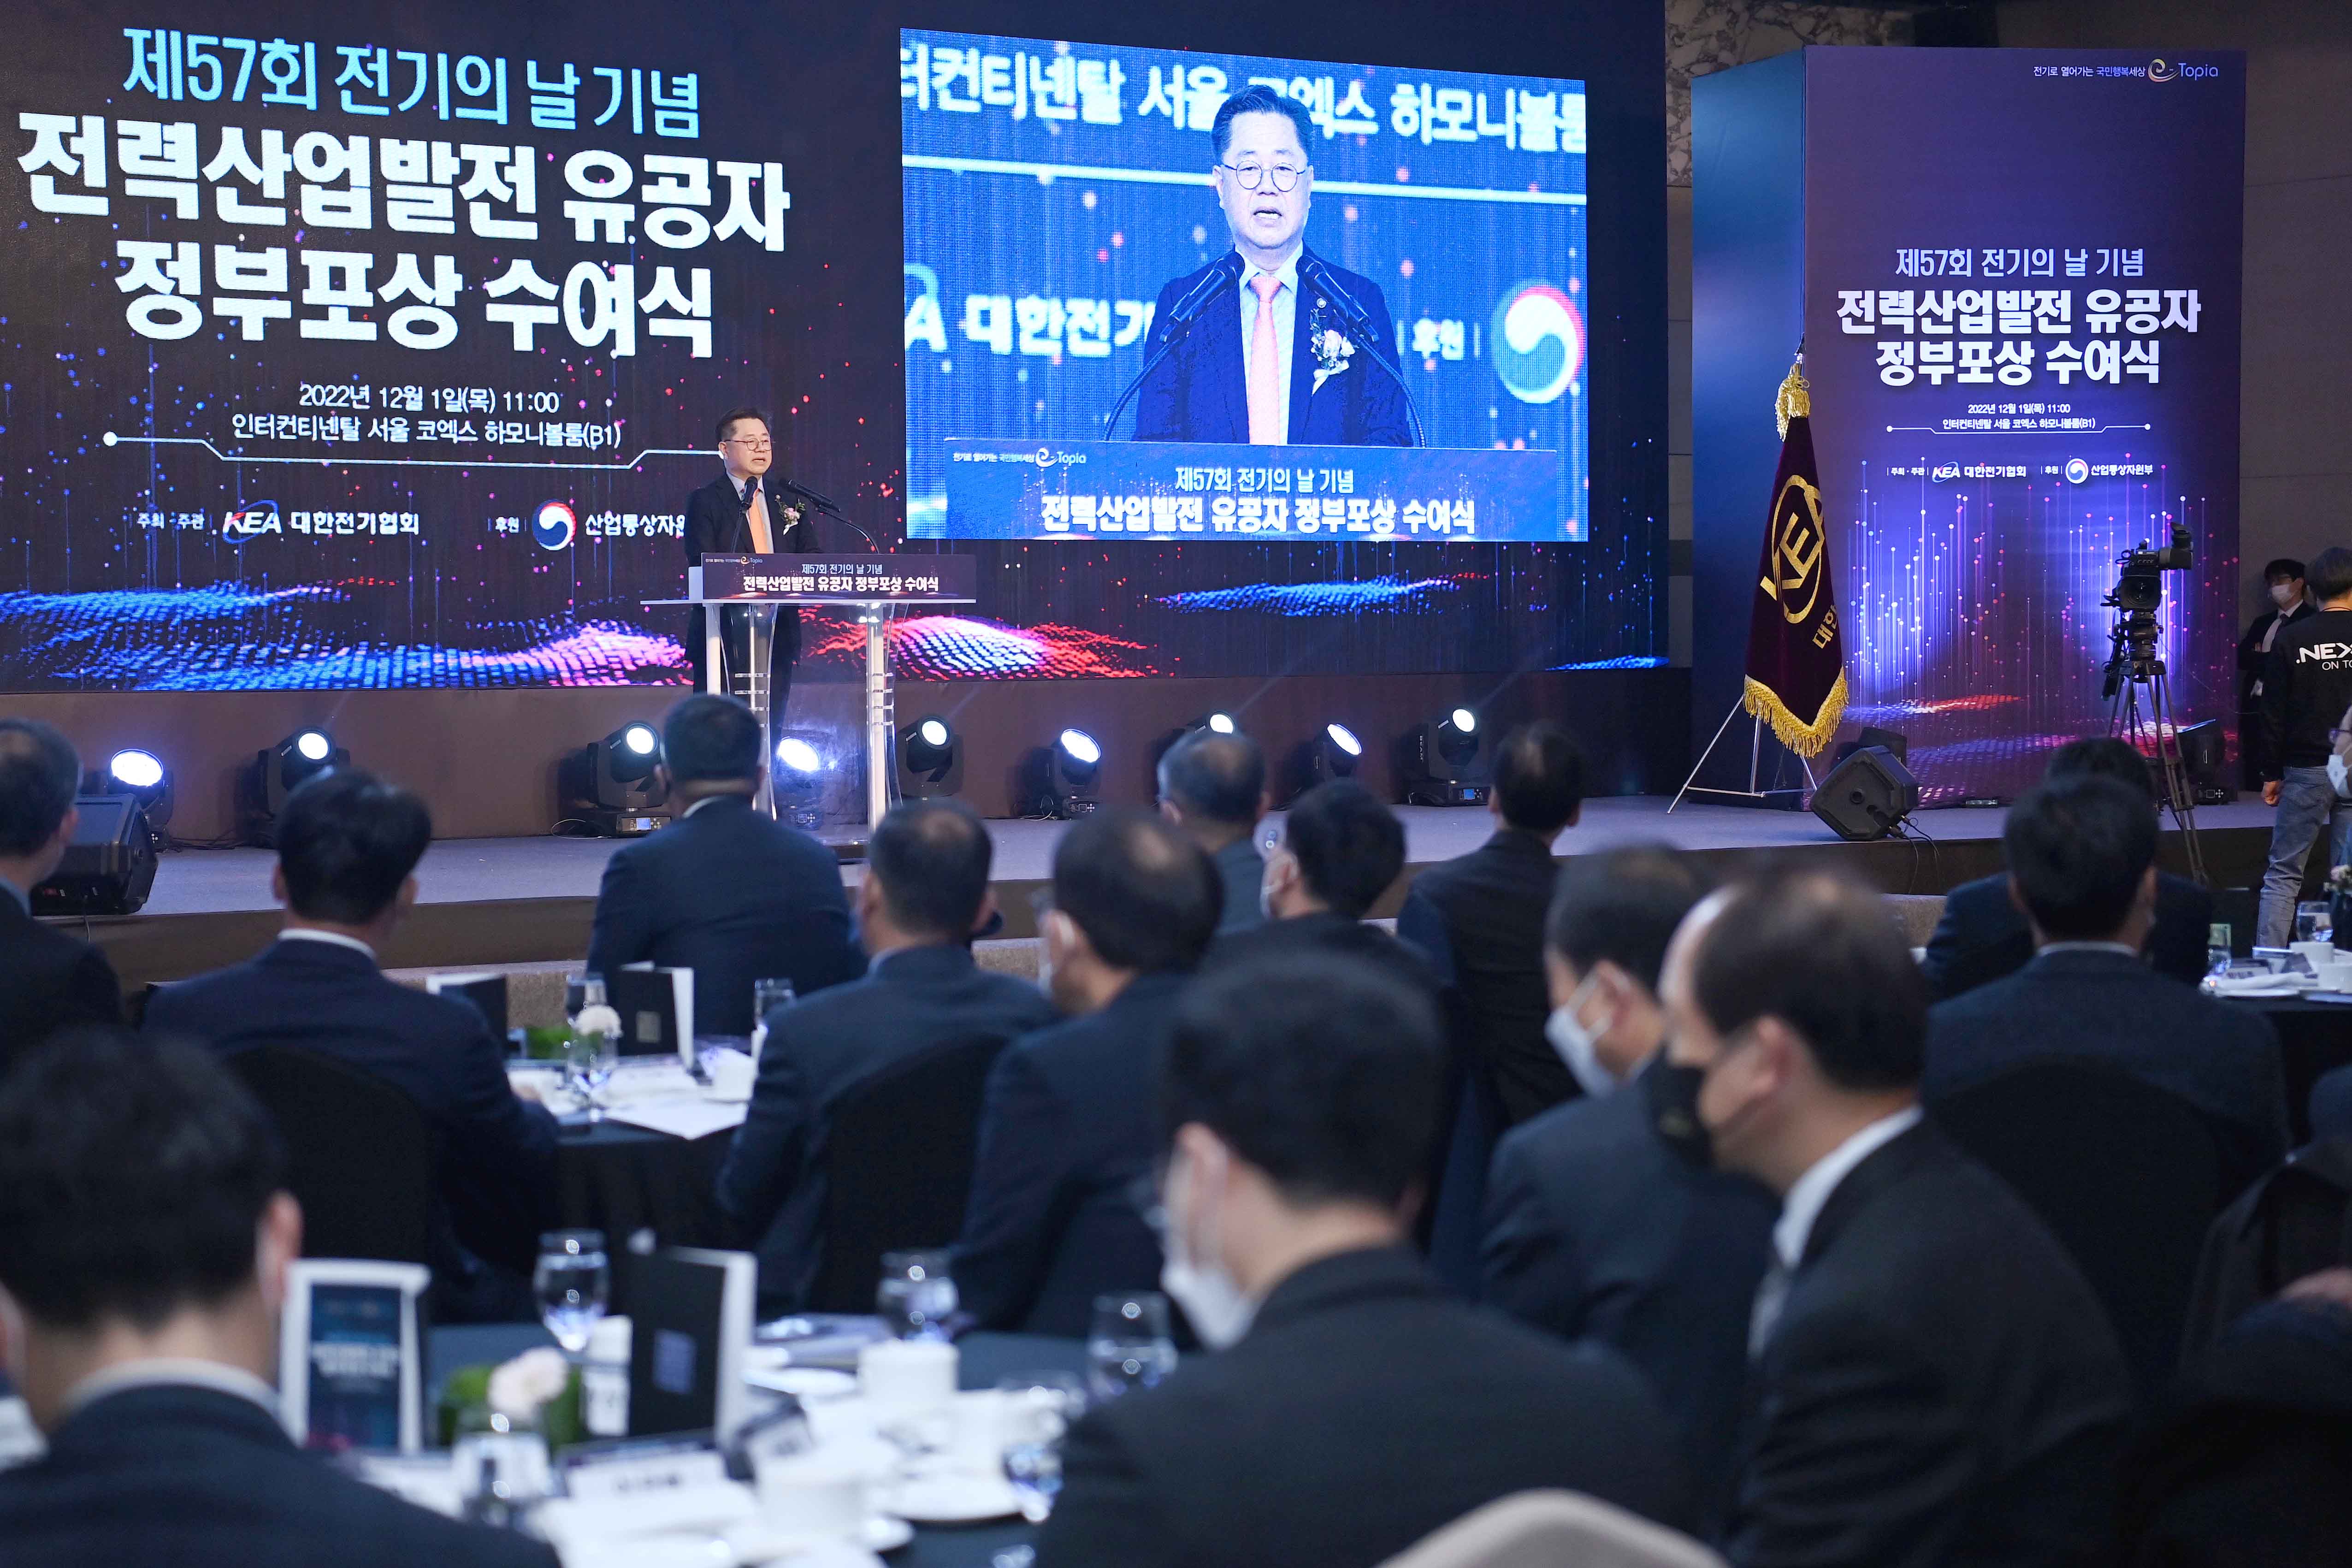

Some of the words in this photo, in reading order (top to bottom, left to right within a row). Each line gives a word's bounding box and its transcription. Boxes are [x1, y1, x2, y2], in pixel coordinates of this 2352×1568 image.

[123, 28, 317, 111] 제57회
[335, 46, 508, 124] 전기의
[526, 60, 580, 130] 날
[593, 67, 699, 138] 기념
[2033, 66, 2058, 77] 전기로
[2061, 66, 2094, 77] 열어가는
[2096, 66, 2146, 77] 국민행복세상
[17, 112, 538, 241] 전력산업발전
[563, 150, 790, 252] 유공자
[1895, 249, 1972, 277] 제57회
[1981, 249, 2054, 277] 전기의
[2064, 249, 2088, 277] 날
[2096, 249, 2143, 277] 기념
[115, 240, 463, 349] 정부포상
[483, 259, 712, 359] 수여식
[1837, 290, 2071, 334] 전력산업발전
[2086, 289, 2201, 334] 유공자
[1412, 319, 1465, 361] 후원
[1876, 341, 2035, 386] 정부포상
[2046, 340, 2159, 385] 수여식
[299, 385, 370, 409] 2022년
[379, 385, 423, 411] 12월
[431, 386, 496, 414] 1일(목)
[503, 391, 559, 413] 11:00
[1968, 403, 1996, 414] 2022년
[1998, 403, 2016, 414] 12월
[2018, 402, 2045, 414] 1일(목)
[2047, 403, 2071, 413] 11:00
[232, 413, 361, 441] 인터컨티넨탈
[367, 417, 410, 443] 서울
[415, 419, 479, 444] 코엑스
[485, 420, 621, 449] 하모니볼룸(B1)
[1943, 419, 1992, 430] 인터컨티넨탈
[1993, 418, 2011, 429] 서울
[2012, 418, 2038, 429] 코엑스
[2039, 417, 2096, 429] 하모니볼룸(B1)
[1175, 467, 1231, 492] 제57회
[1236, 468, 1290, 493] 전기의
[1297, 469, 1314, 493] 날
[1320, 469, 1353, 493] 기념
[1891, 467, 1905, 476] 주최
[1910, 467, 1925, 476] 주관
[1932, 467, 1961, 478] KEA
[1964, 466, 2026, 478] 대한전기협회
[2045, 466, 2058, 474] 후원
[2091, 464, 2153, 476] 산업통상자원부
[222, 512, 282, 534] KEA
[290, 511, 419, 535] 대한전기협회
[1041, 495, 1204, 532] 전력산업발전
[1211, 497, 1289, 533] 유공자
[1294, 498, 1396, 534] 정부포상
[1402, 500, 1476, 535] 수여식
[802, 564, 827, 574] 제57회
[829, 564, 854, 574] 전기의
[856, 564, 864, 574] 날
[866, 564, 882, 574] 기념
[743, 576, 815, 591] 전력산업발전
[818, 576, 853, 592] 유공자
[855, 577, 902, 592] 정부포상
[905, 577, 939, 592] 수여식
[2322, 661, 2339, 670] ON
